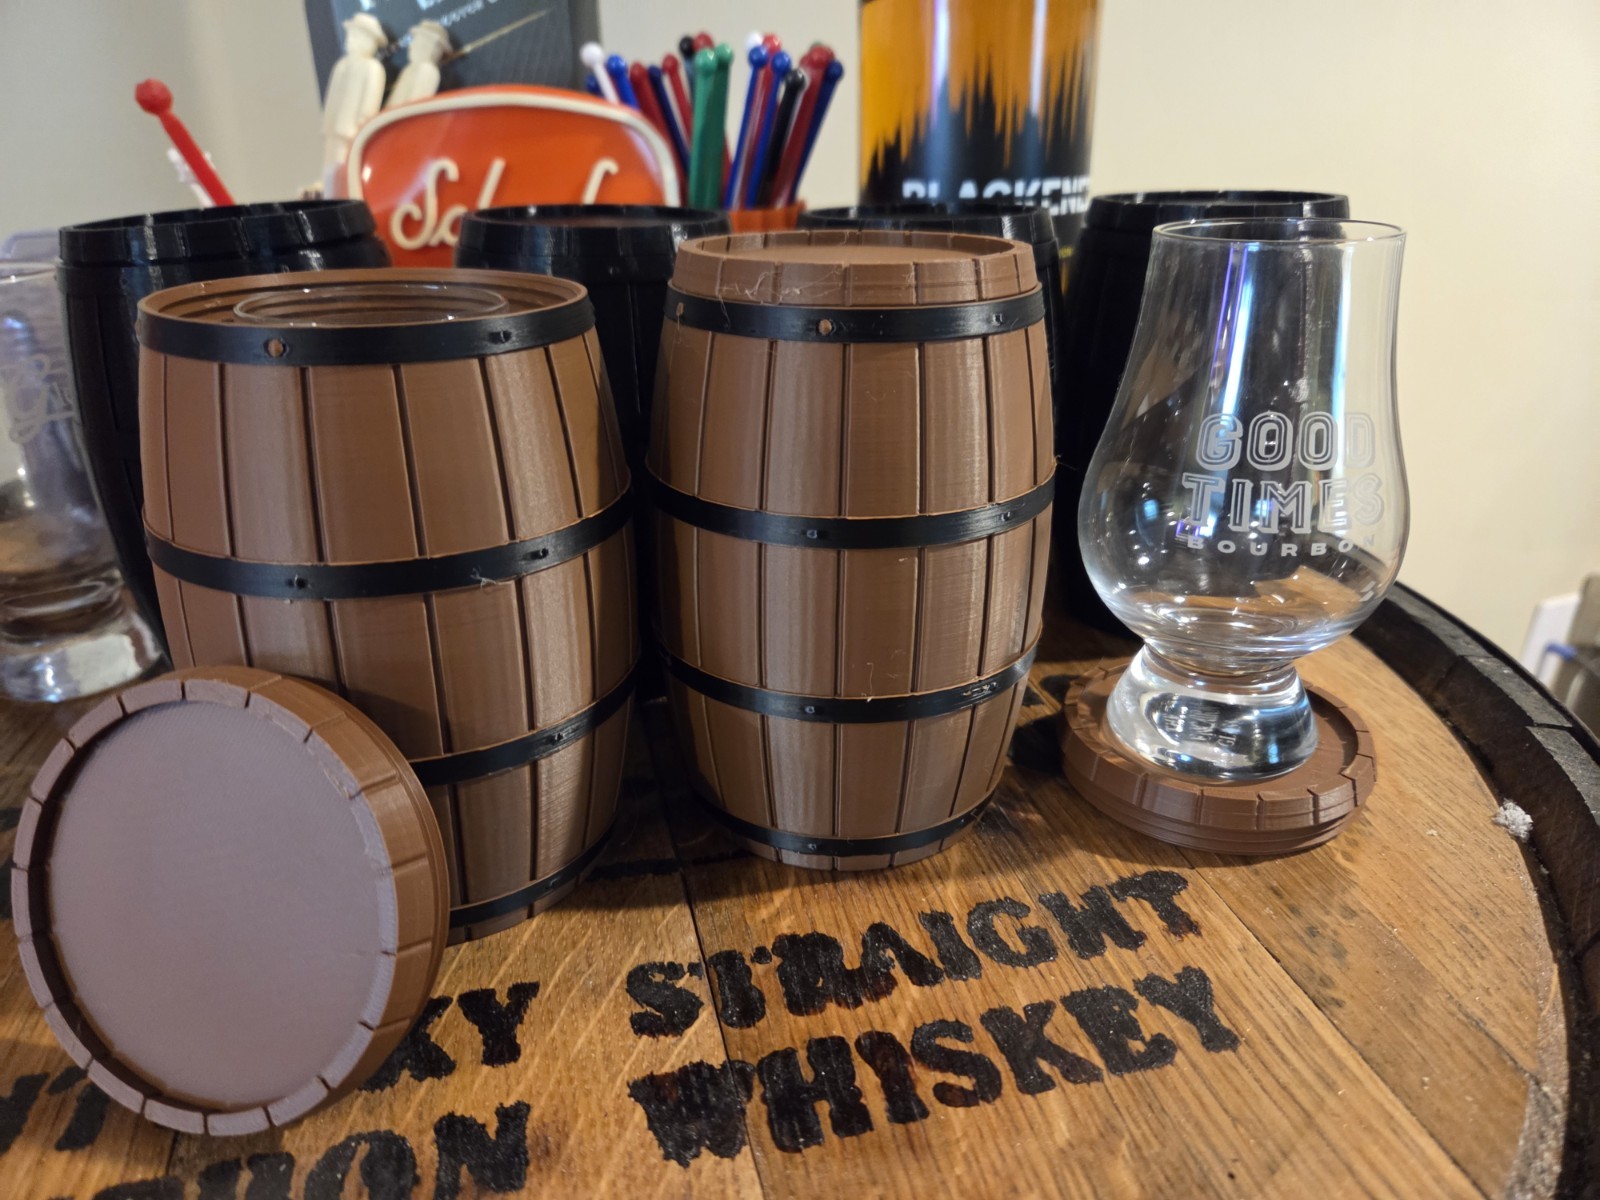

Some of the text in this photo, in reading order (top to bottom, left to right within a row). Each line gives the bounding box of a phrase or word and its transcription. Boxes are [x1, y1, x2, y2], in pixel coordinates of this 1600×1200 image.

[1195, 410, 1376, 472] GOOD
[1181, 472, 1385, 534] TIMES
[1187, 534, 1376, 557] BOURBON
[626, 869, 1202, 1038] STRAIGHT
[626, 965, 1241, 1168] WHISKEY
